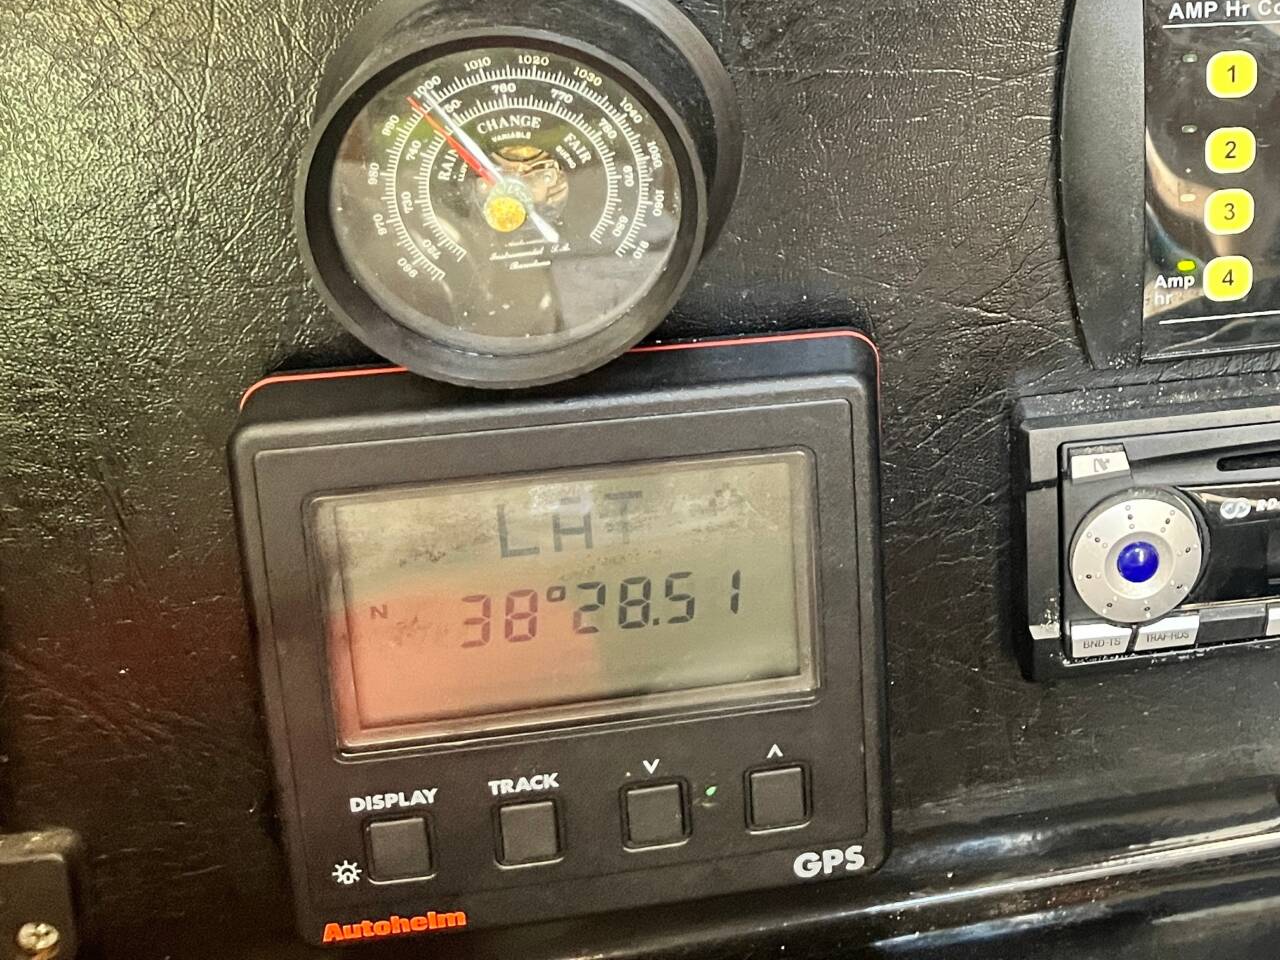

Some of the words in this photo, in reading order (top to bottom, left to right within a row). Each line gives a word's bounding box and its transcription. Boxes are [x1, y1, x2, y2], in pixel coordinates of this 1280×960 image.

[1168, 1, 1218, 20] AMP
[1226, 0, 1251, 18] Hr
[464, 56, 491, 72] 1010
[518, 54, 549, 67] 1020
[573, 66, 602, 86] 1030
[491, 82, 516, 95] 760
[550, 88, 574, 103] 770
[620, 96, 643, 124] 1040
[476, 115, 541, 134] CHANGE
[490, 131, 531, 142] VARIABLE
[405, 140, 422, 161] 740
[563, 132, 591, 164] FAIR
[646, 140, 663, 168] 1050
[1225, 141, 1237, 160] 2
[652, 189, 665, 217] 1060
[1224, 202, 1236, 221] 3
[373, 213, 387, 236] 970
[1155, 275, 1195, 289] Amp
[1222, 269, 1235, 286] 4
[1155, 292, 1174, 305] hr
[498, 489, 643, 558] LAT
[488, 771, 560, 796] TRACK
[349, 787, 439, 813] DISPLAY
[793, 844, 866, 878] GPS
[322, 909, 467, 943] Autohelm
